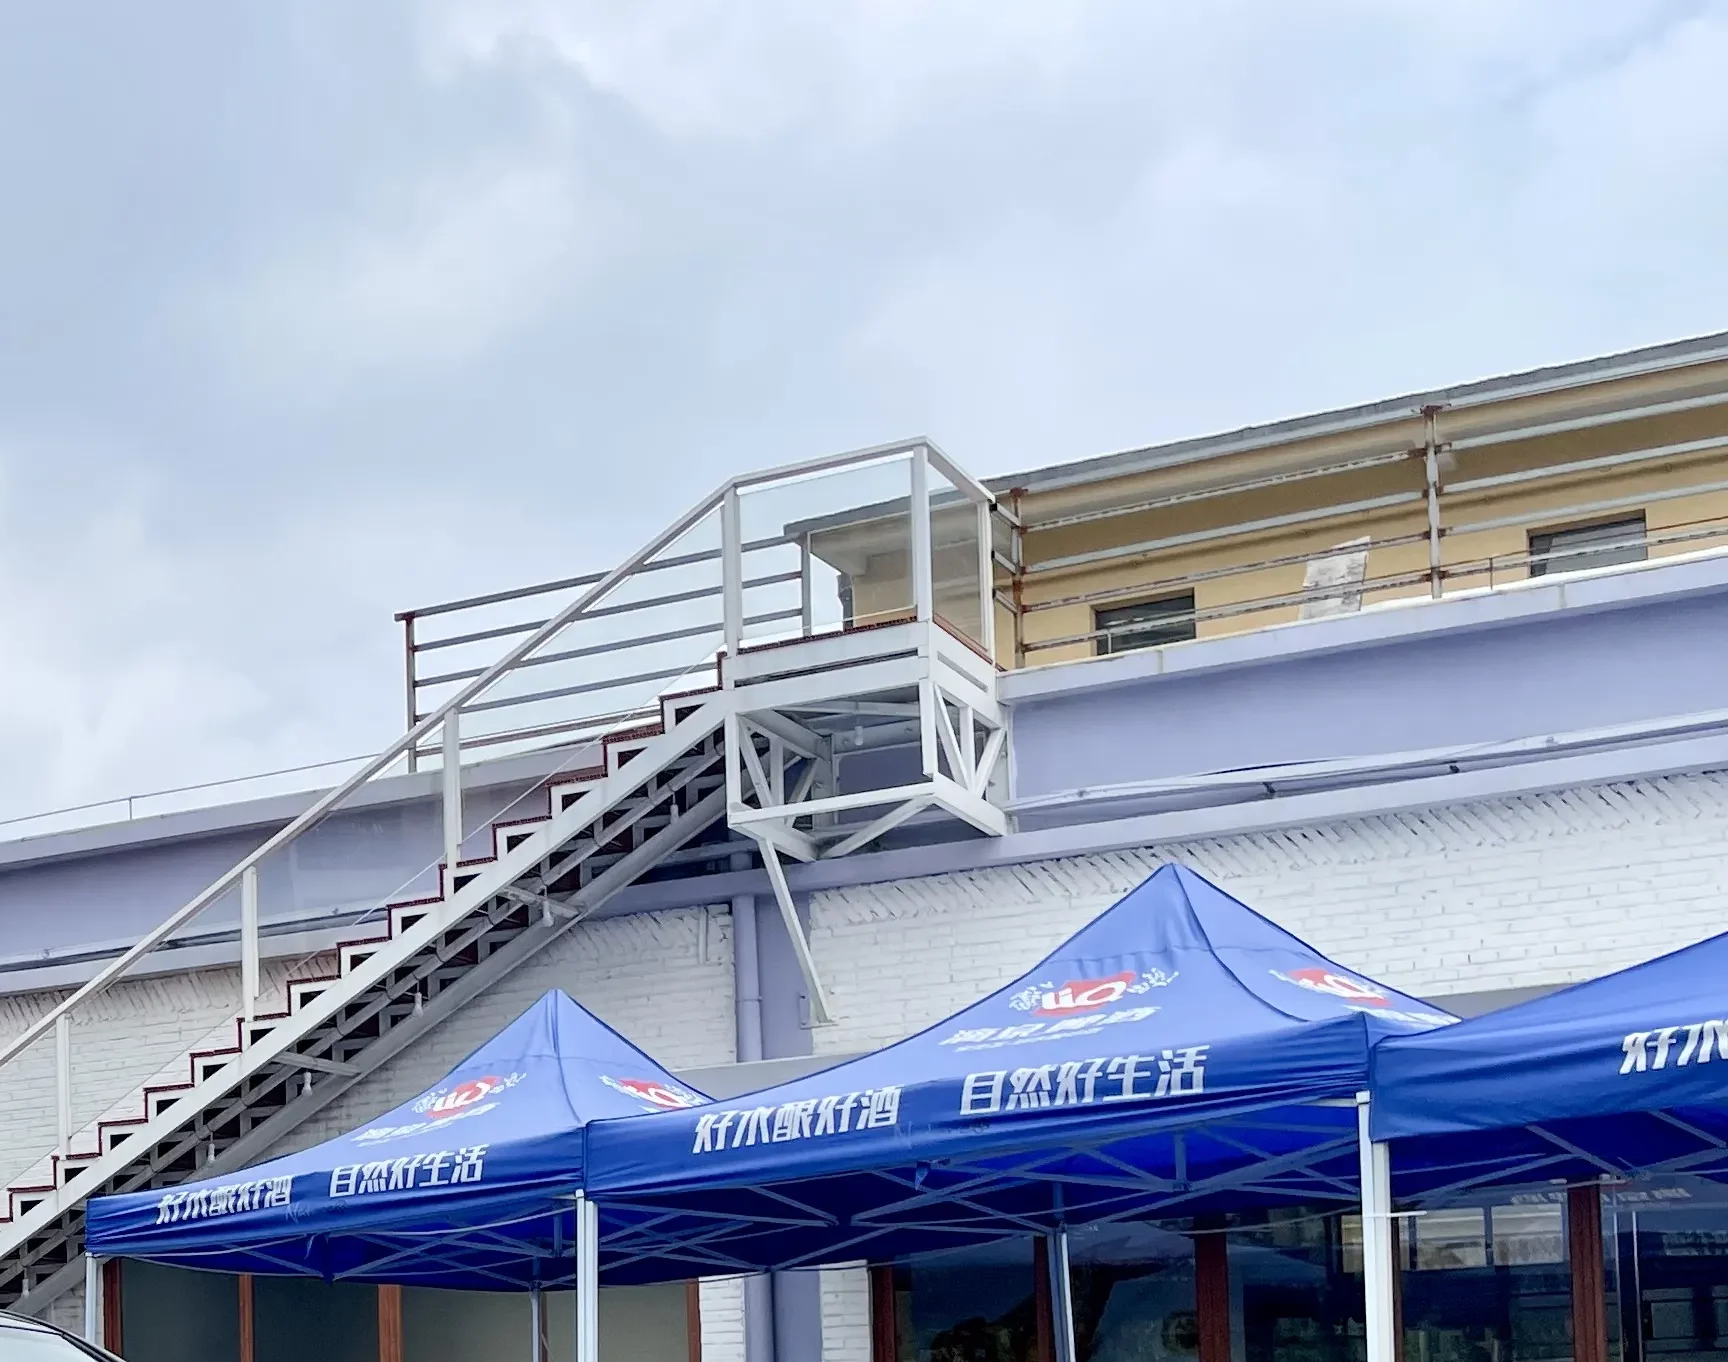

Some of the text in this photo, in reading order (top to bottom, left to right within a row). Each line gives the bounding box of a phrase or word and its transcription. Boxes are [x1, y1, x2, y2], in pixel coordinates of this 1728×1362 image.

[1619, 1018, 1728, 1075] 好水
[692, 1084, 905, 1155] 好水酿好酒
[959, 1045, 1211, 1116] 自然好生活
[329, 1144, 491, 1198] 自然好生活
